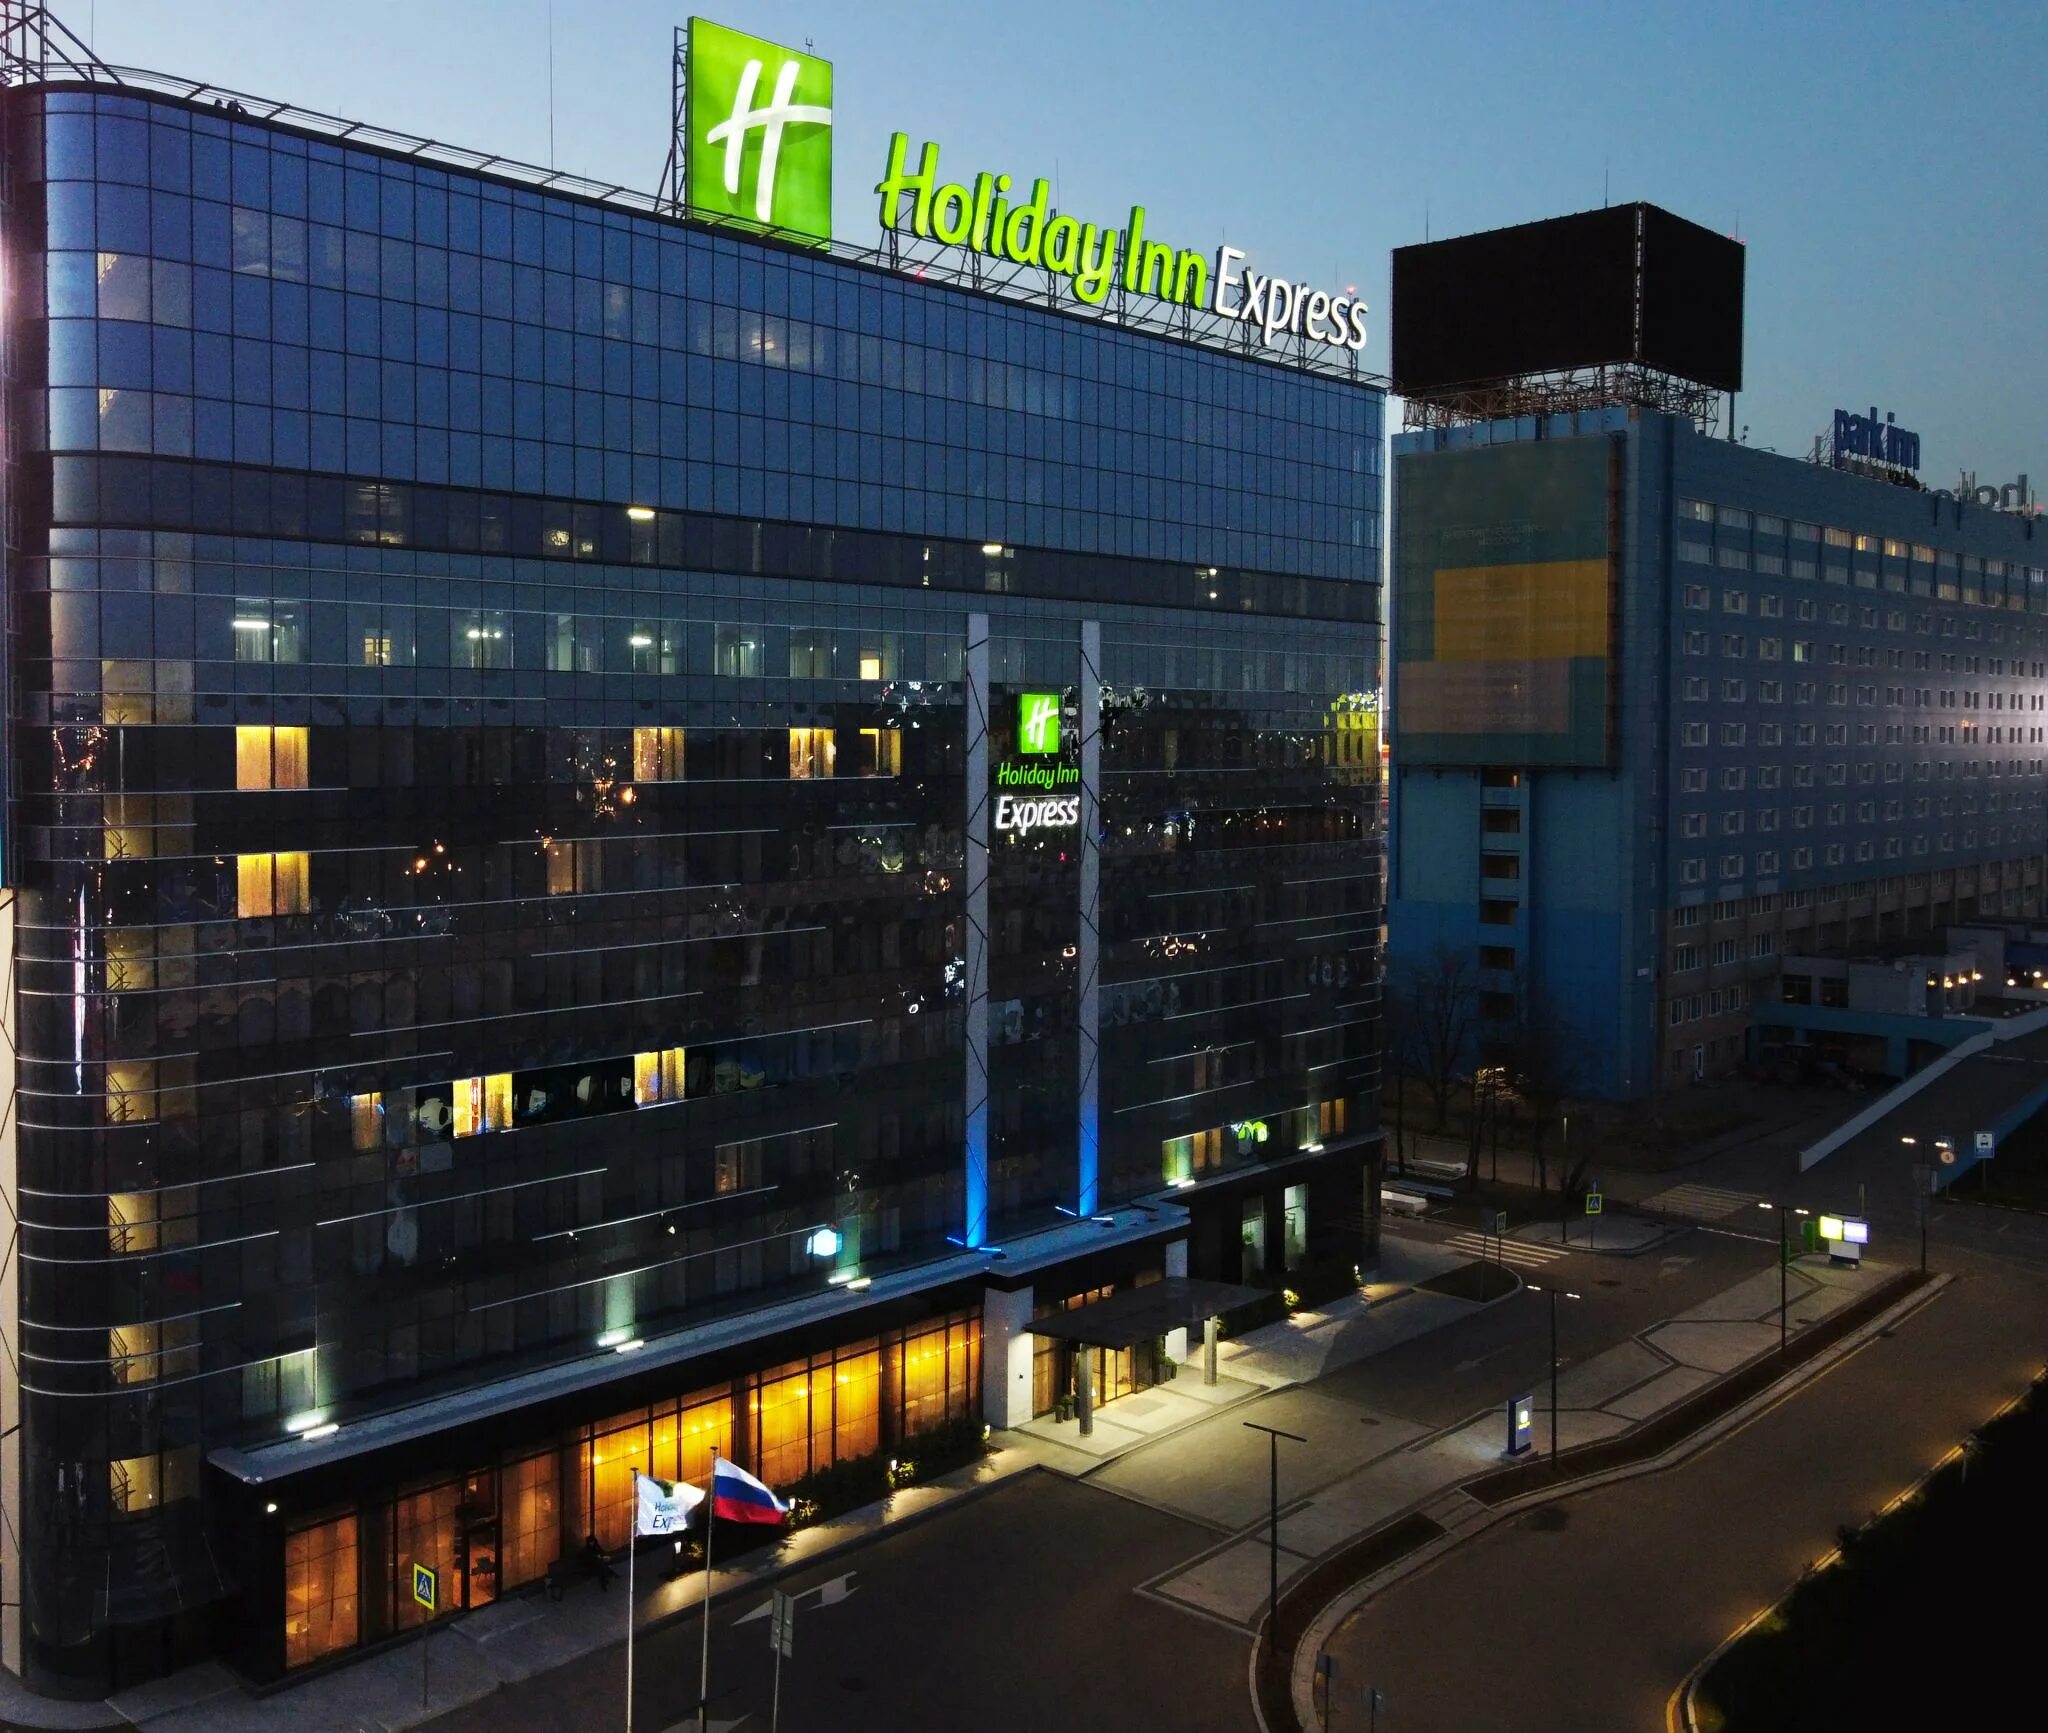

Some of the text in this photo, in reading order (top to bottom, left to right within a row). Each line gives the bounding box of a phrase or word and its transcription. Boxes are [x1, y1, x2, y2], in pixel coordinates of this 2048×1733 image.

[874, 131, 1368, 351] Holiday Inn Express
[998, 762, 1079, 789] Holiday Inn
[995, 795, 1080, 836] Express
